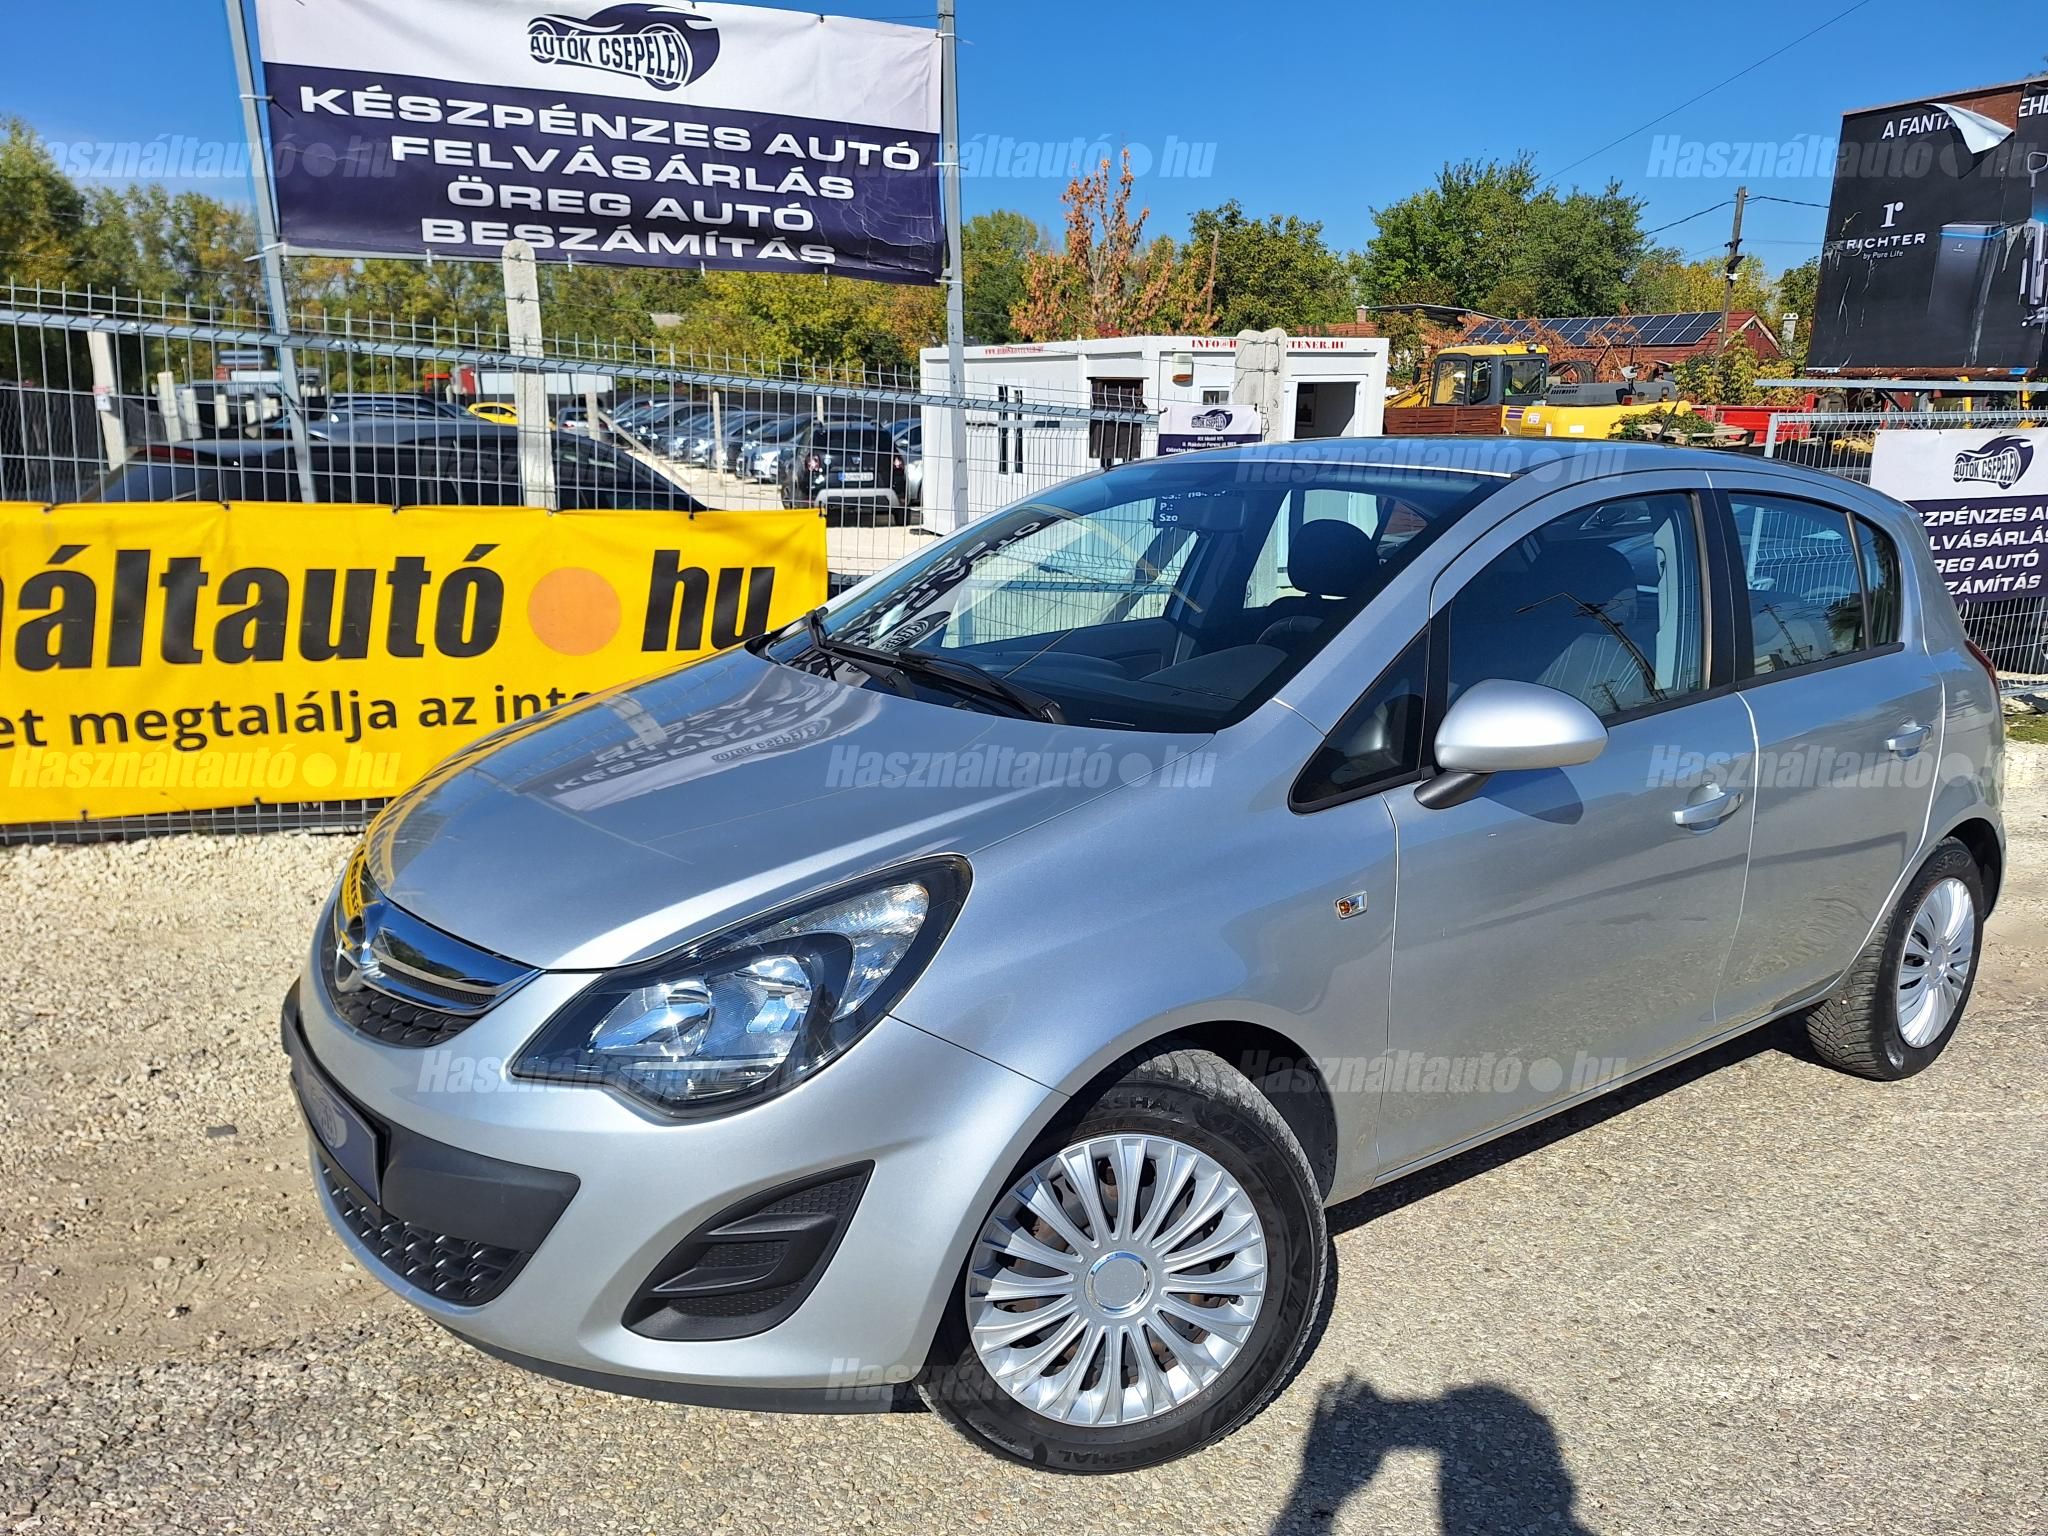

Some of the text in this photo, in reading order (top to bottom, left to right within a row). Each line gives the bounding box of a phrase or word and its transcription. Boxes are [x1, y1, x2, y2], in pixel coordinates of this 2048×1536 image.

[530, 29, 688, 82] AUTÓK CSEPELEN
[300, 85, 920, 172] KÉSZPÉNZES AUTÓ
[1881, 121, 1895, 140] A
[391, 135, 855, 200] FELVÁSÁRLÁS
[447, 175, 814, 232] ÖREG AUTÓ
[421, 218, 836, 265] BESZÁMÍTÁS
[1846, 233, 1926, 250] RICHTER
[1863, 252, 1871, 261] by
[1890, 250, 1904, 258] Life
[1919, 506, 2048, 527] ZPÉNZES A
[1934, 548, 2040, 574] REG AUTÓ
[1944, 572, 2042, 596] ZÁMÍTÁS
[0, 543, 505, 672] áltautó
[641, 549, 776, 651] hu
[70, 690, 398, 752] megtalálja
[418, 696, 478, 728] az
